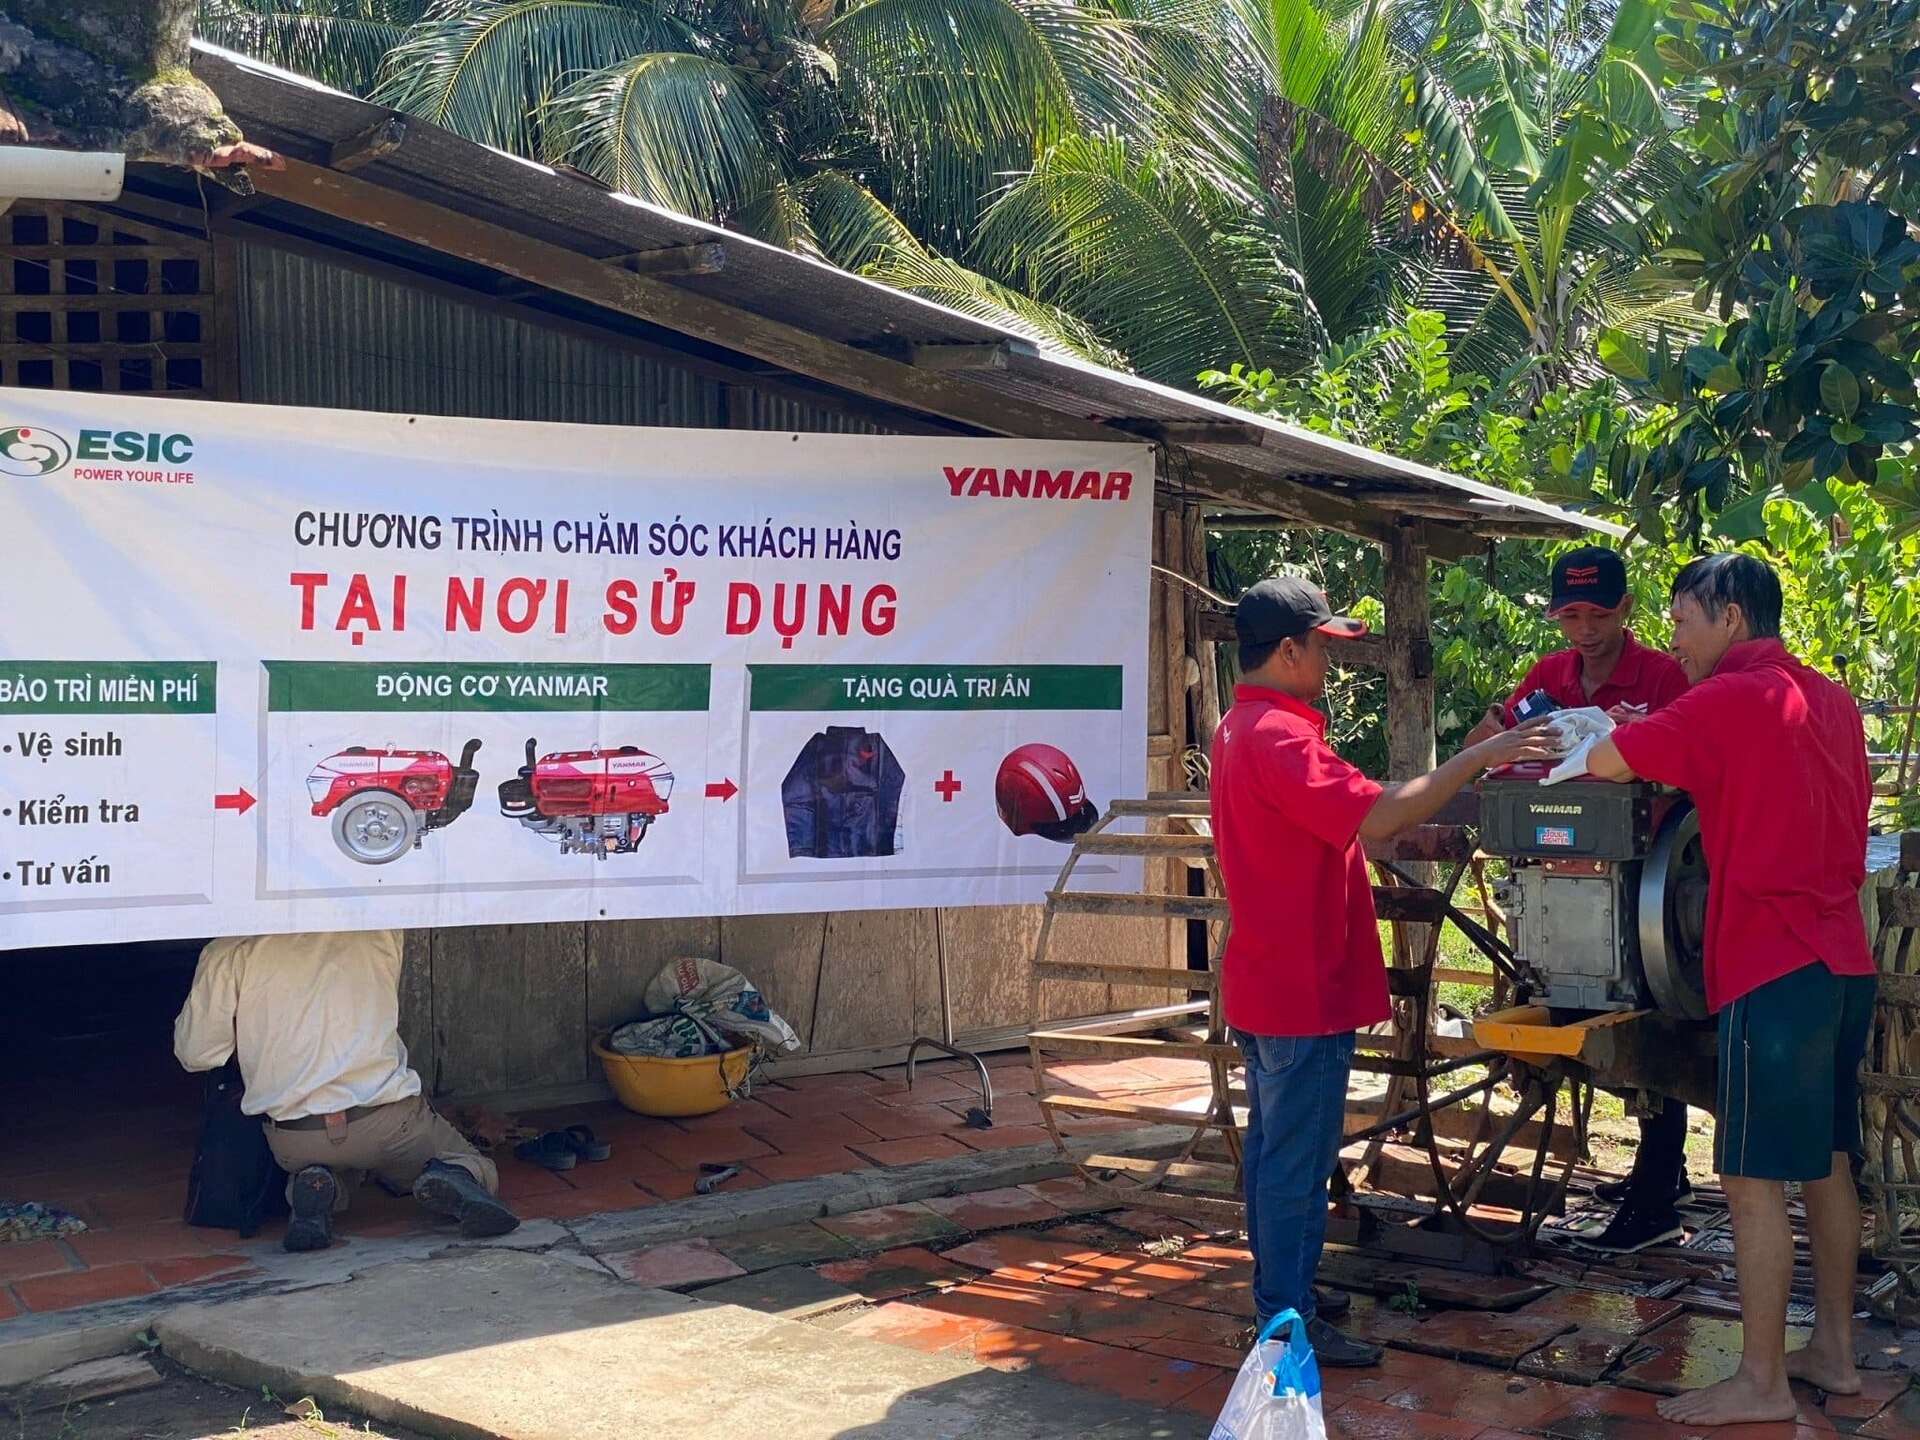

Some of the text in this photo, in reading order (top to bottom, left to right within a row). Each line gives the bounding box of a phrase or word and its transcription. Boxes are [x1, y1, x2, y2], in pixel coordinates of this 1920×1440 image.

[76, 429, 194, 464] ESIC
[74, 469, 194, 484] POWER YOUR LIFE
[943, 467, 1132, 500] YANMAR
[294, 509, 901, 561] CHƯƠNG TRÌNH CHĂM SÓC KHÁCH HÀNG
[290, 568, 897, 649] TẠI NƠI SỬ DỤNG
[0, 674, 47, 702] BẢO
[54, 673, 92, 702] TRÌ
[162, 673, 198, 702] PHÍ
[376, 672, 609, 702] ĐỘNG CƠ YANMAR
[843, 675, 903, 703] TẶNG
[909, 673, 958, 699] QUÀ
[18, 732, 122, 763] Vệ sinh
[18, 794, 139, 826] Kiểm tra
[1529, 804, 1583, 814] YANMAR
[16, 855, 111, 887] Tư vấn
